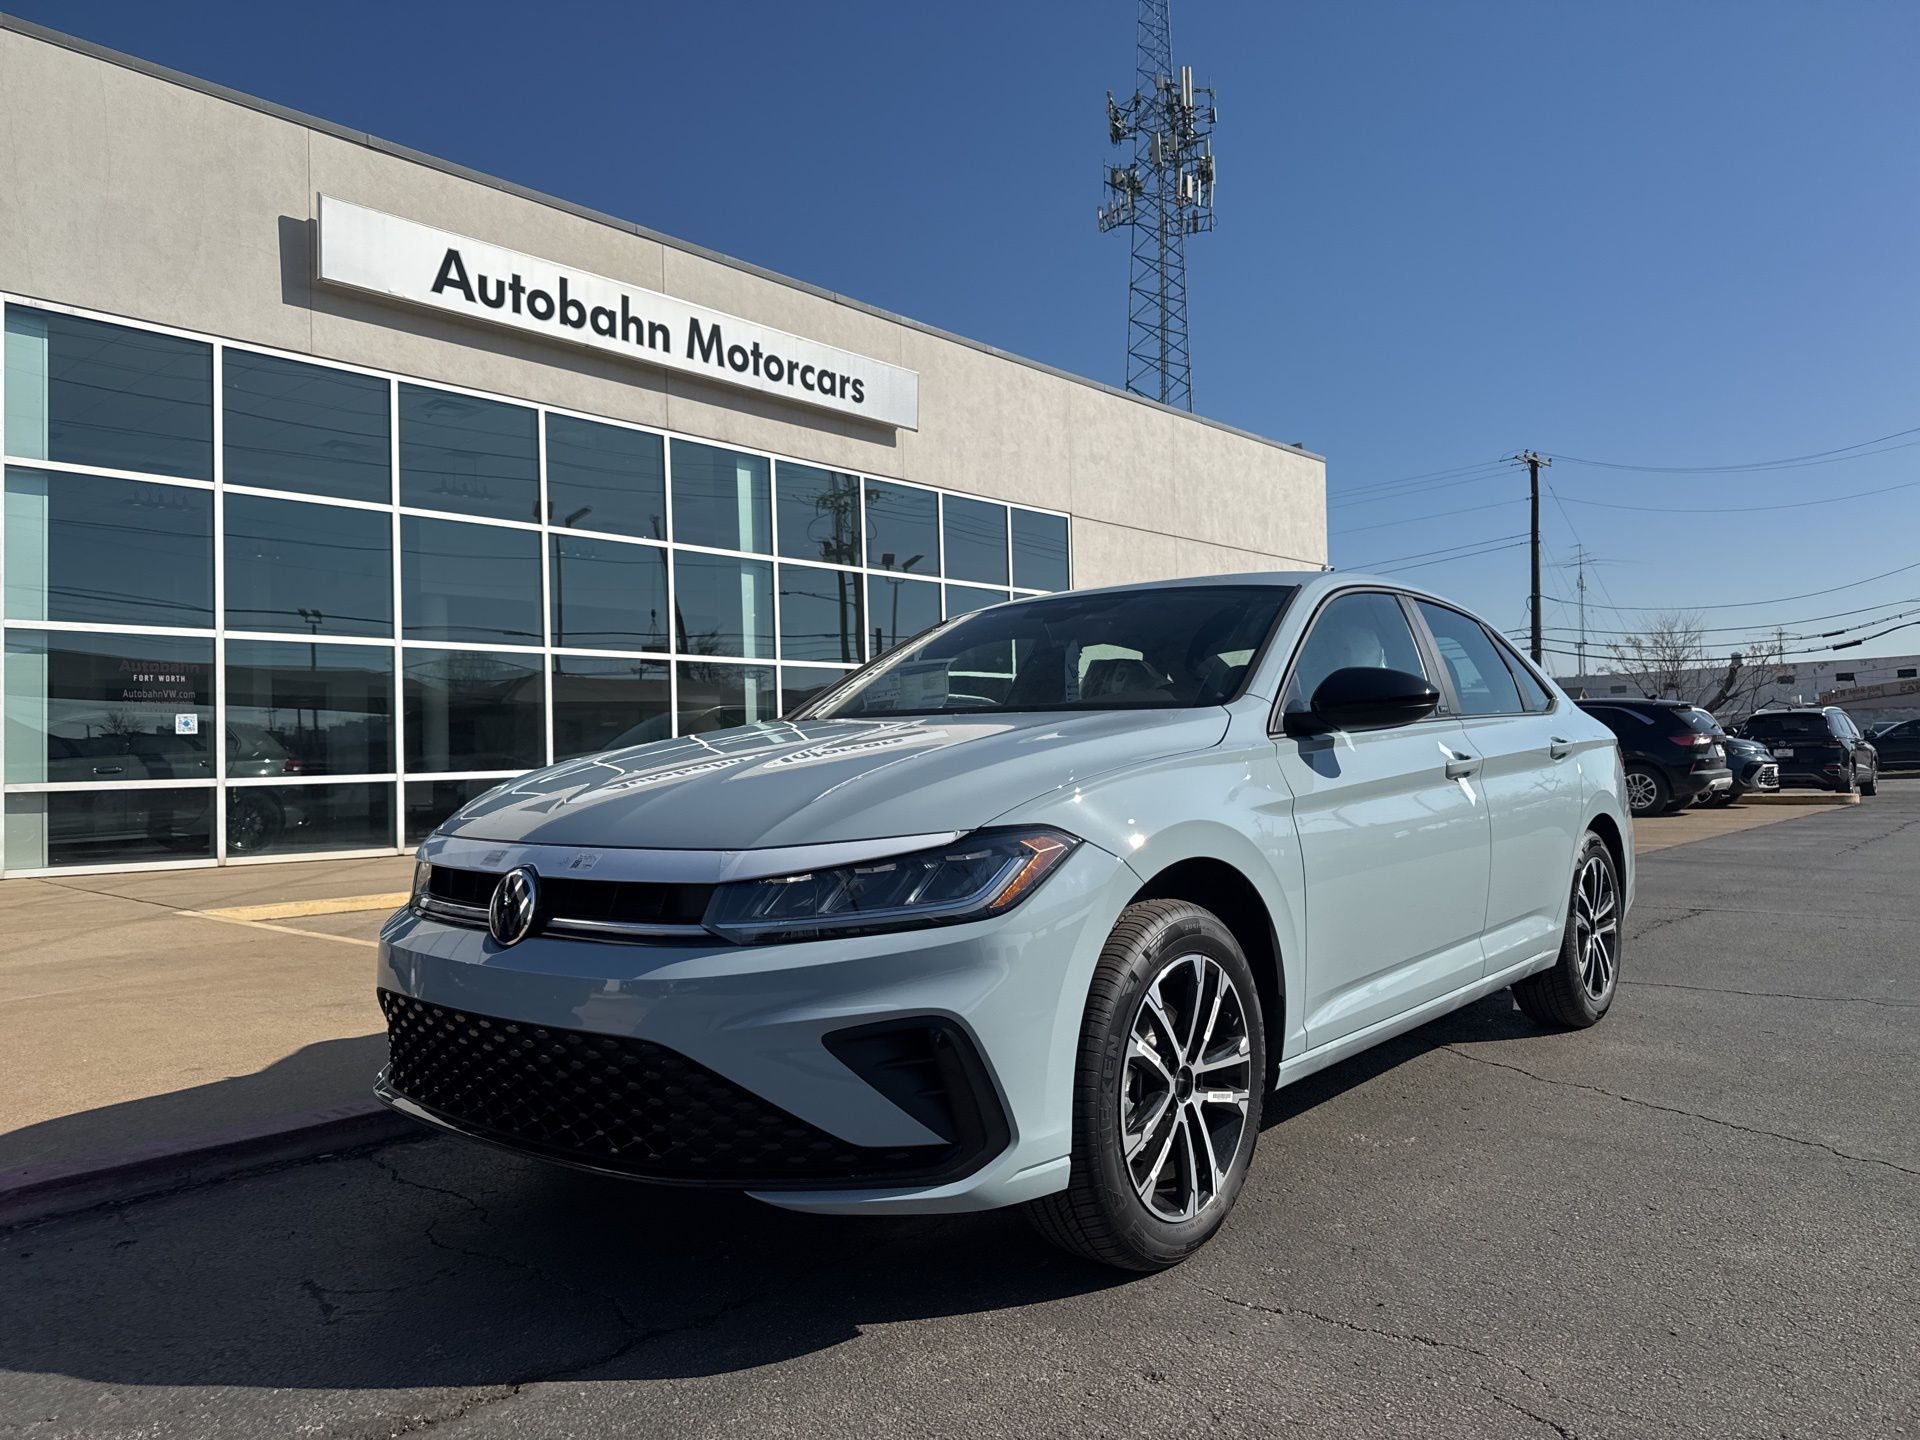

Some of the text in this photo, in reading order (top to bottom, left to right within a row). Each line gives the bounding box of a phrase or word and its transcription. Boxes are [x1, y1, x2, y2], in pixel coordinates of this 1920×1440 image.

[430, 247, 865, 404] Autobahn Motorcars
[120, 660, 199, 673] Autobahn
[133, 674, 186, 683] FORT WORTH
[122, 689, 196, 698] AutobahnVW.com
